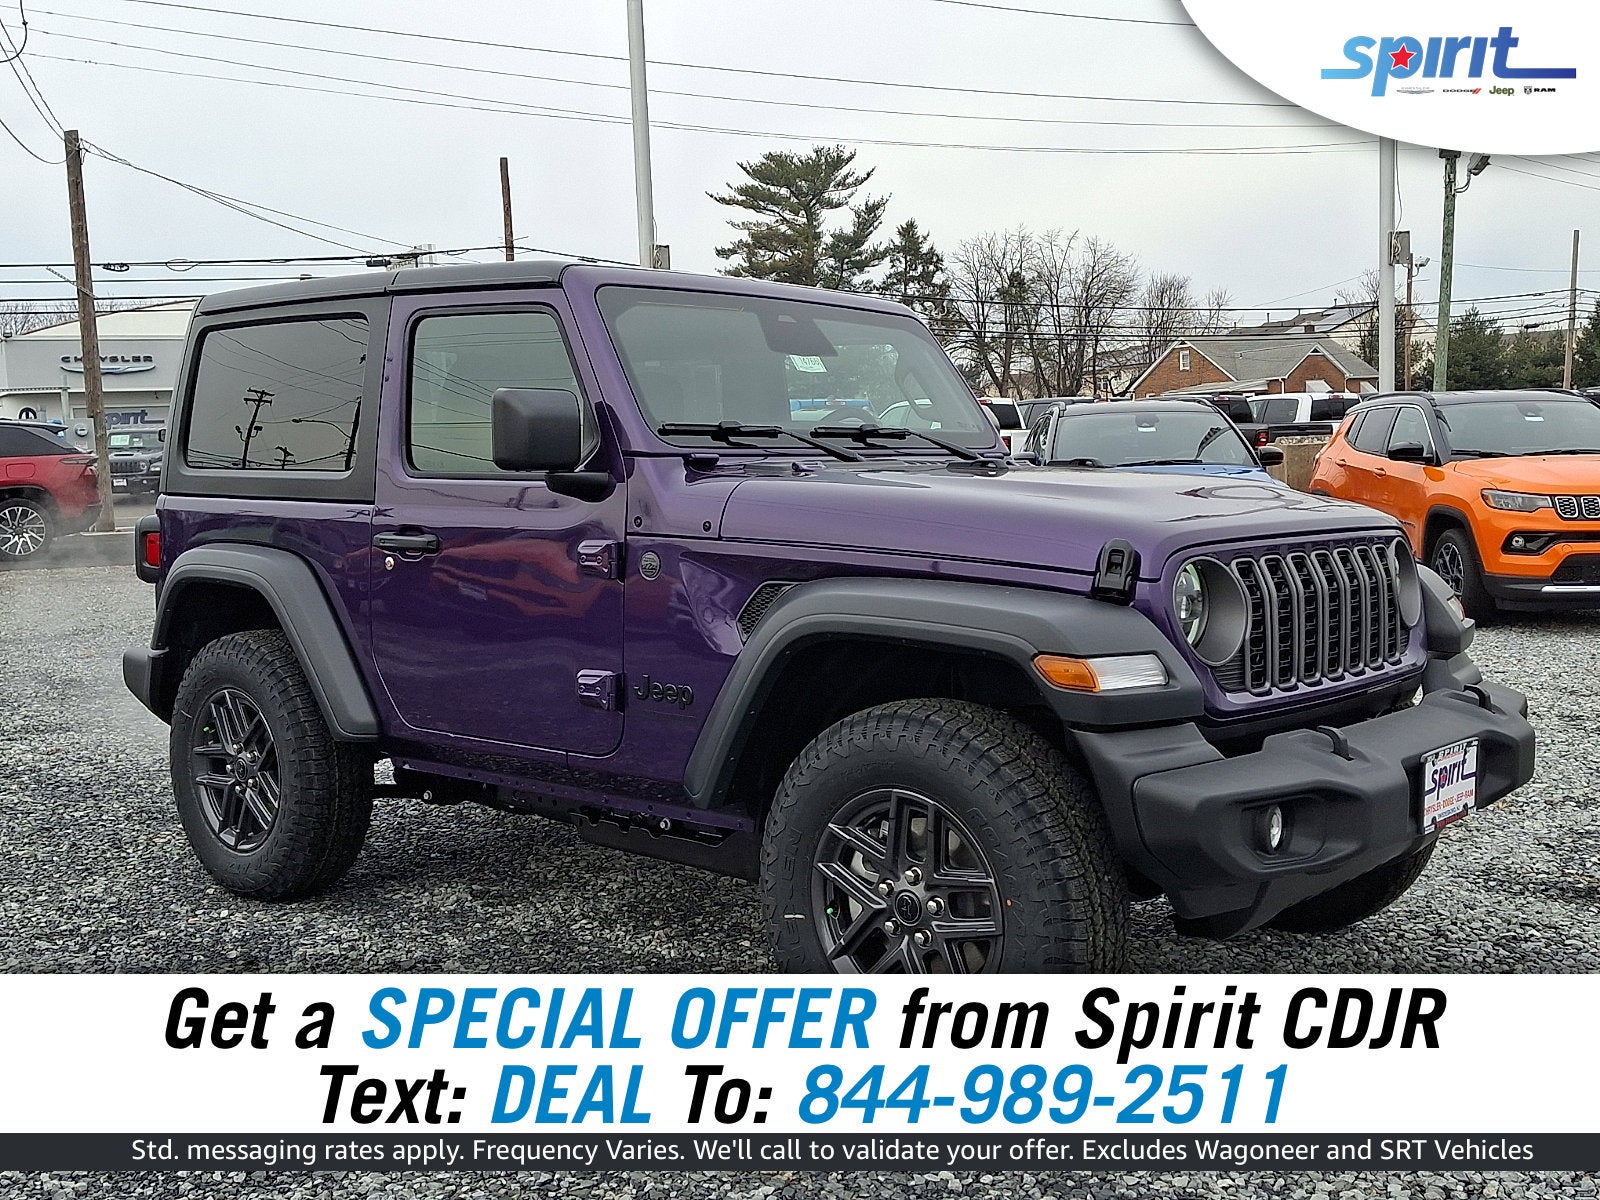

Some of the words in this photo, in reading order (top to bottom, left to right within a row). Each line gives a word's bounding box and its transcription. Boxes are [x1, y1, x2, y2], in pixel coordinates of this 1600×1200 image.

[61, 355, 153, 363] CHYSLER
[105, 409, 165, 431] pirit
[634, 674, 695, 710] Jeep
[1439, 743, 1467, 758] SPIRIT
[1424, 758, 1476, 800] spirit
